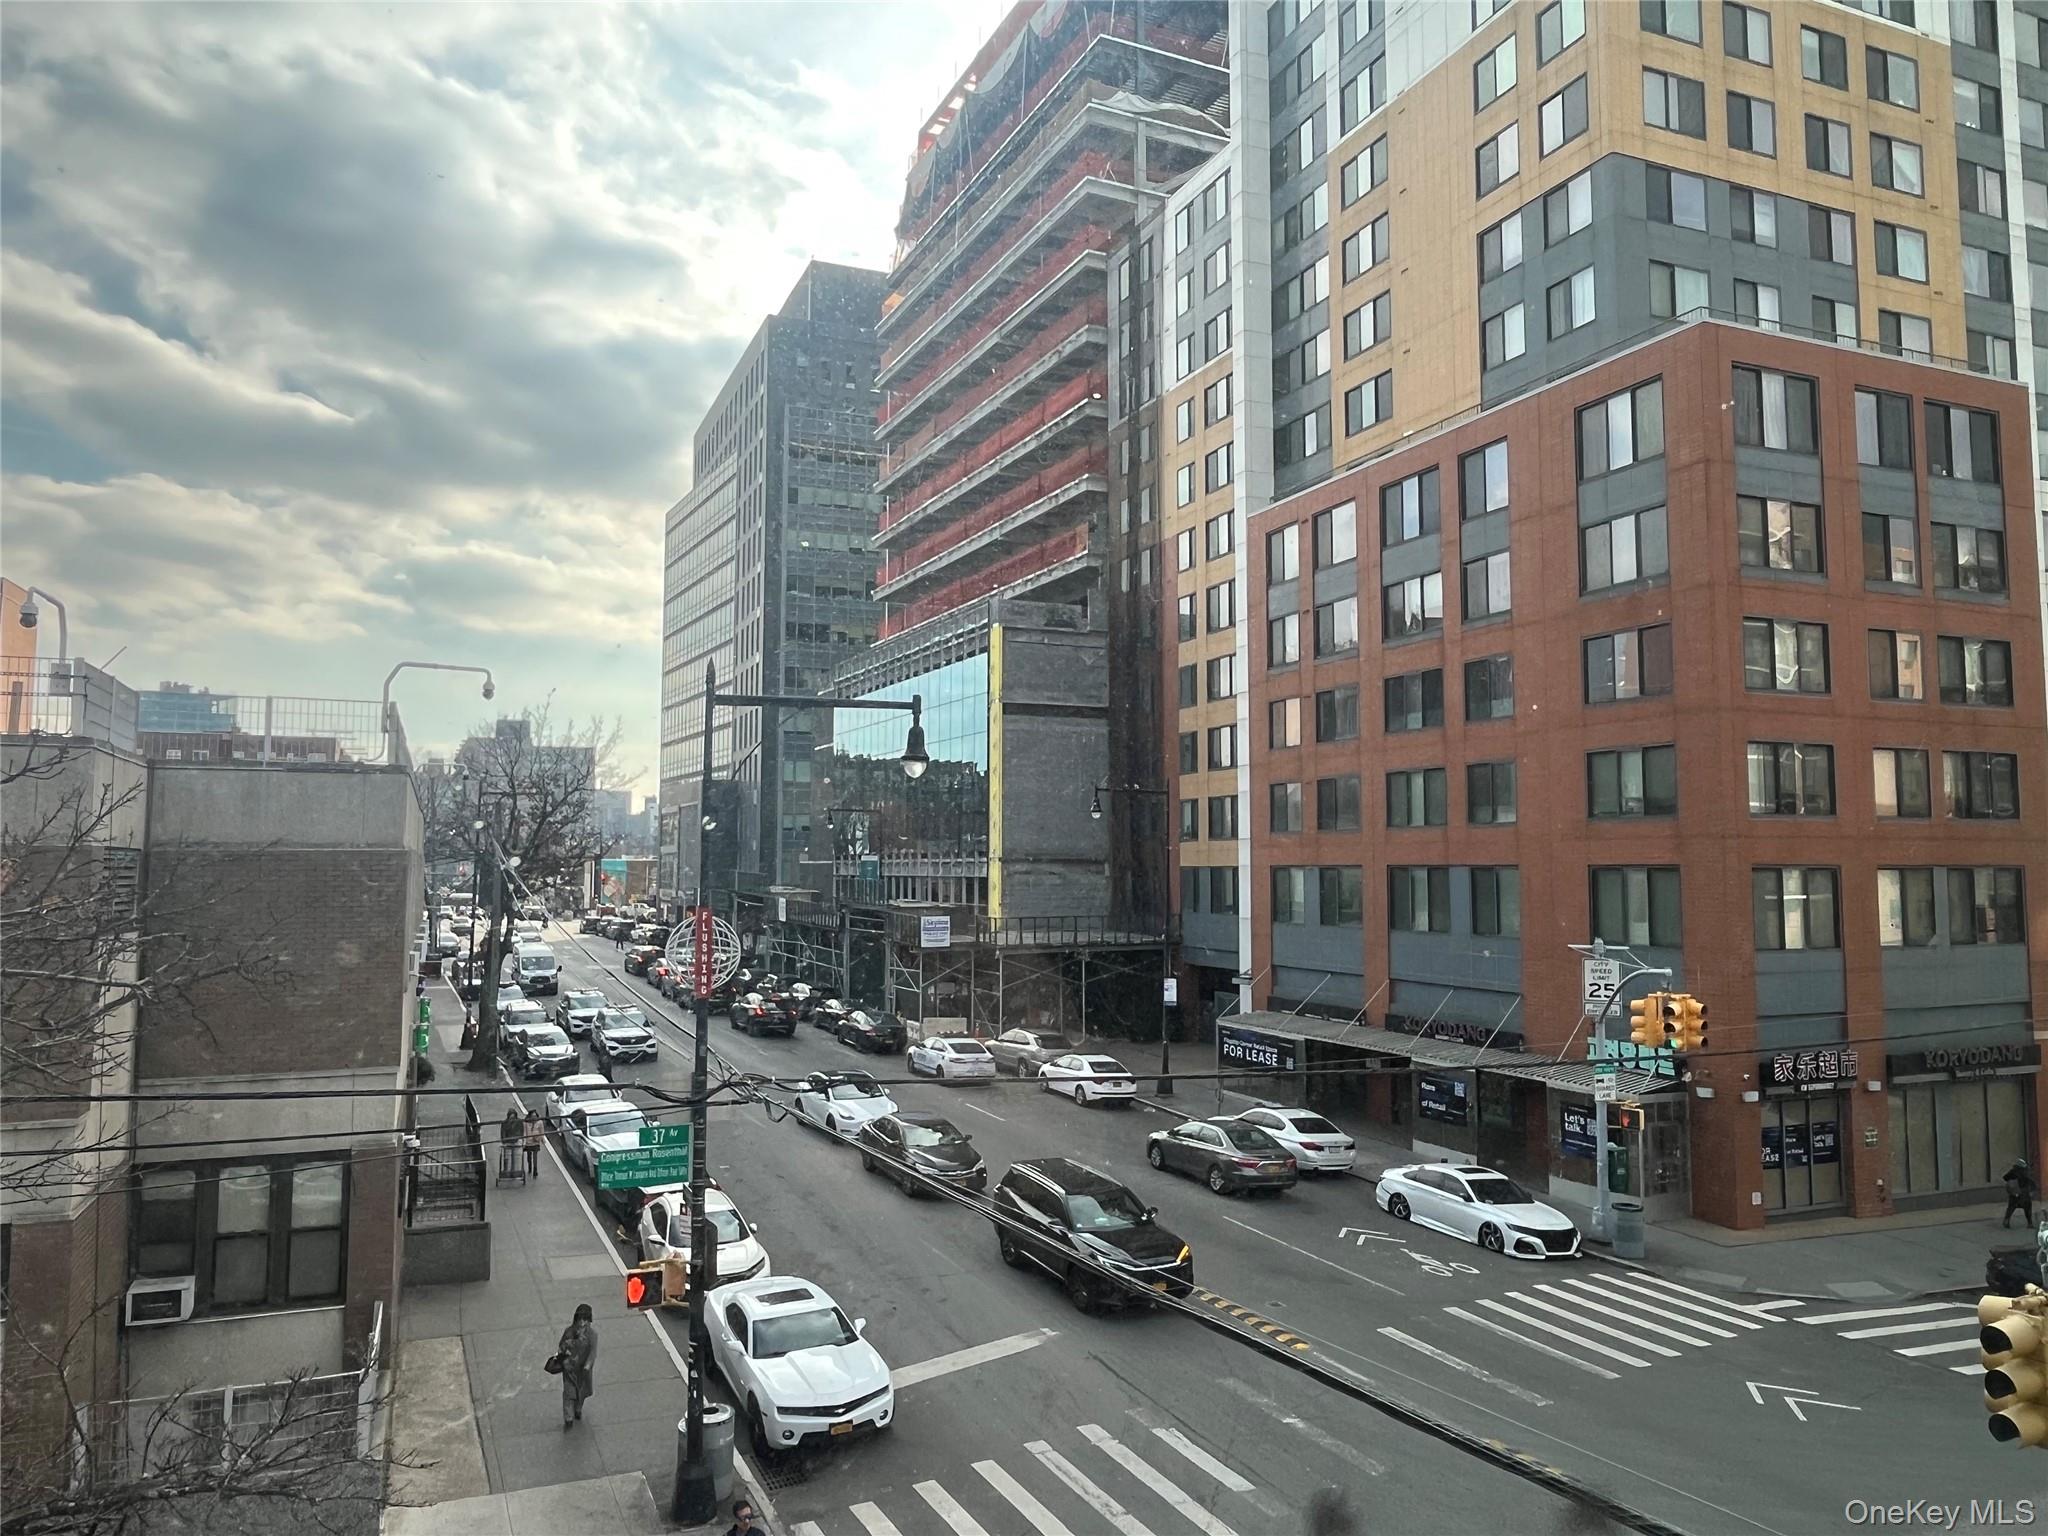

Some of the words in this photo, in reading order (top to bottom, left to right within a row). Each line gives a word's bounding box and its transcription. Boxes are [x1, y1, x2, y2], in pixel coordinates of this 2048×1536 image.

[1588, 983, 1615, 998] 25
[1403, 1015, 1486, 1040] KORYODANG
[1223, 1043, 1243, 1059] FOR
[1246, 1048, 1278, 1066] LEASE
[1924, 1046, 2024, 1068] KORYODANG
[1774, 1050, 1858, 1082] 家乐超市
[1564, 1112, 1584, 1124] Let's
[1565, 1122, 1584, 1133] talk.
[652, 1129, 665, 1144] 37
[669, 1129, 678, 1137] Av
[601, 1150, 650, 1164] Congressman
[652, 1145, 688, 1158] Rosenthal
